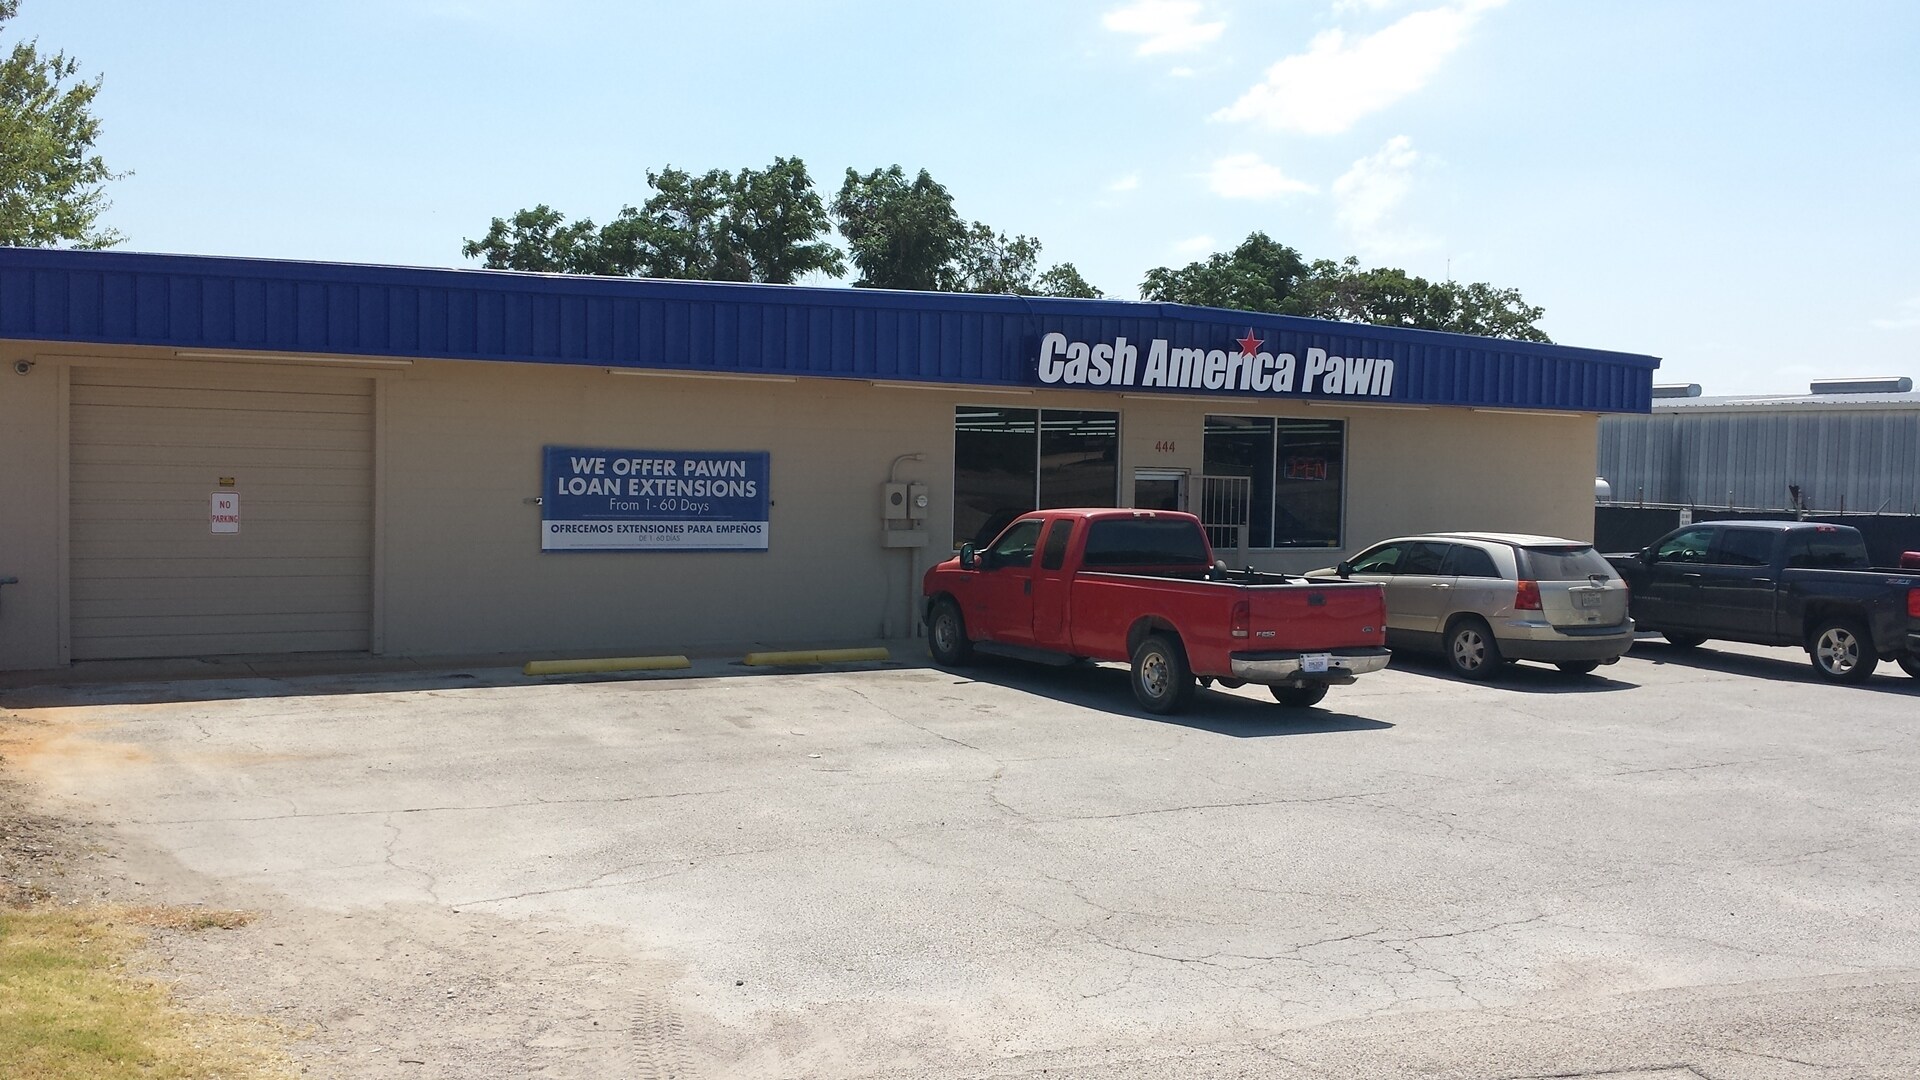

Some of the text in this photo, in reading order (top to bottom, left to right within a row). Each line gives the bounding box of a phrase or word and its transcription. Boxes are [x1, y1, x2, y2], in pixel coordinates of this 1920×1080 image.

[1037, 332, 1395, 397] Cash America Pawn
[1155, 440, 1175, 453] 444
[570, 456, 746, 478] WE OFFER PAWN
[558, 477, 757, 498] LOAN EXTENSIONS
[219, 500, 231, 509] NO
[609, 498, 640, 511] From
[680, 499, 710, 515] Days
[212, 515, 239, 523] PARKING
[550, 522, 762, 534] OFRECEMOS EXTENSIONES PARA EMPEÑOS
